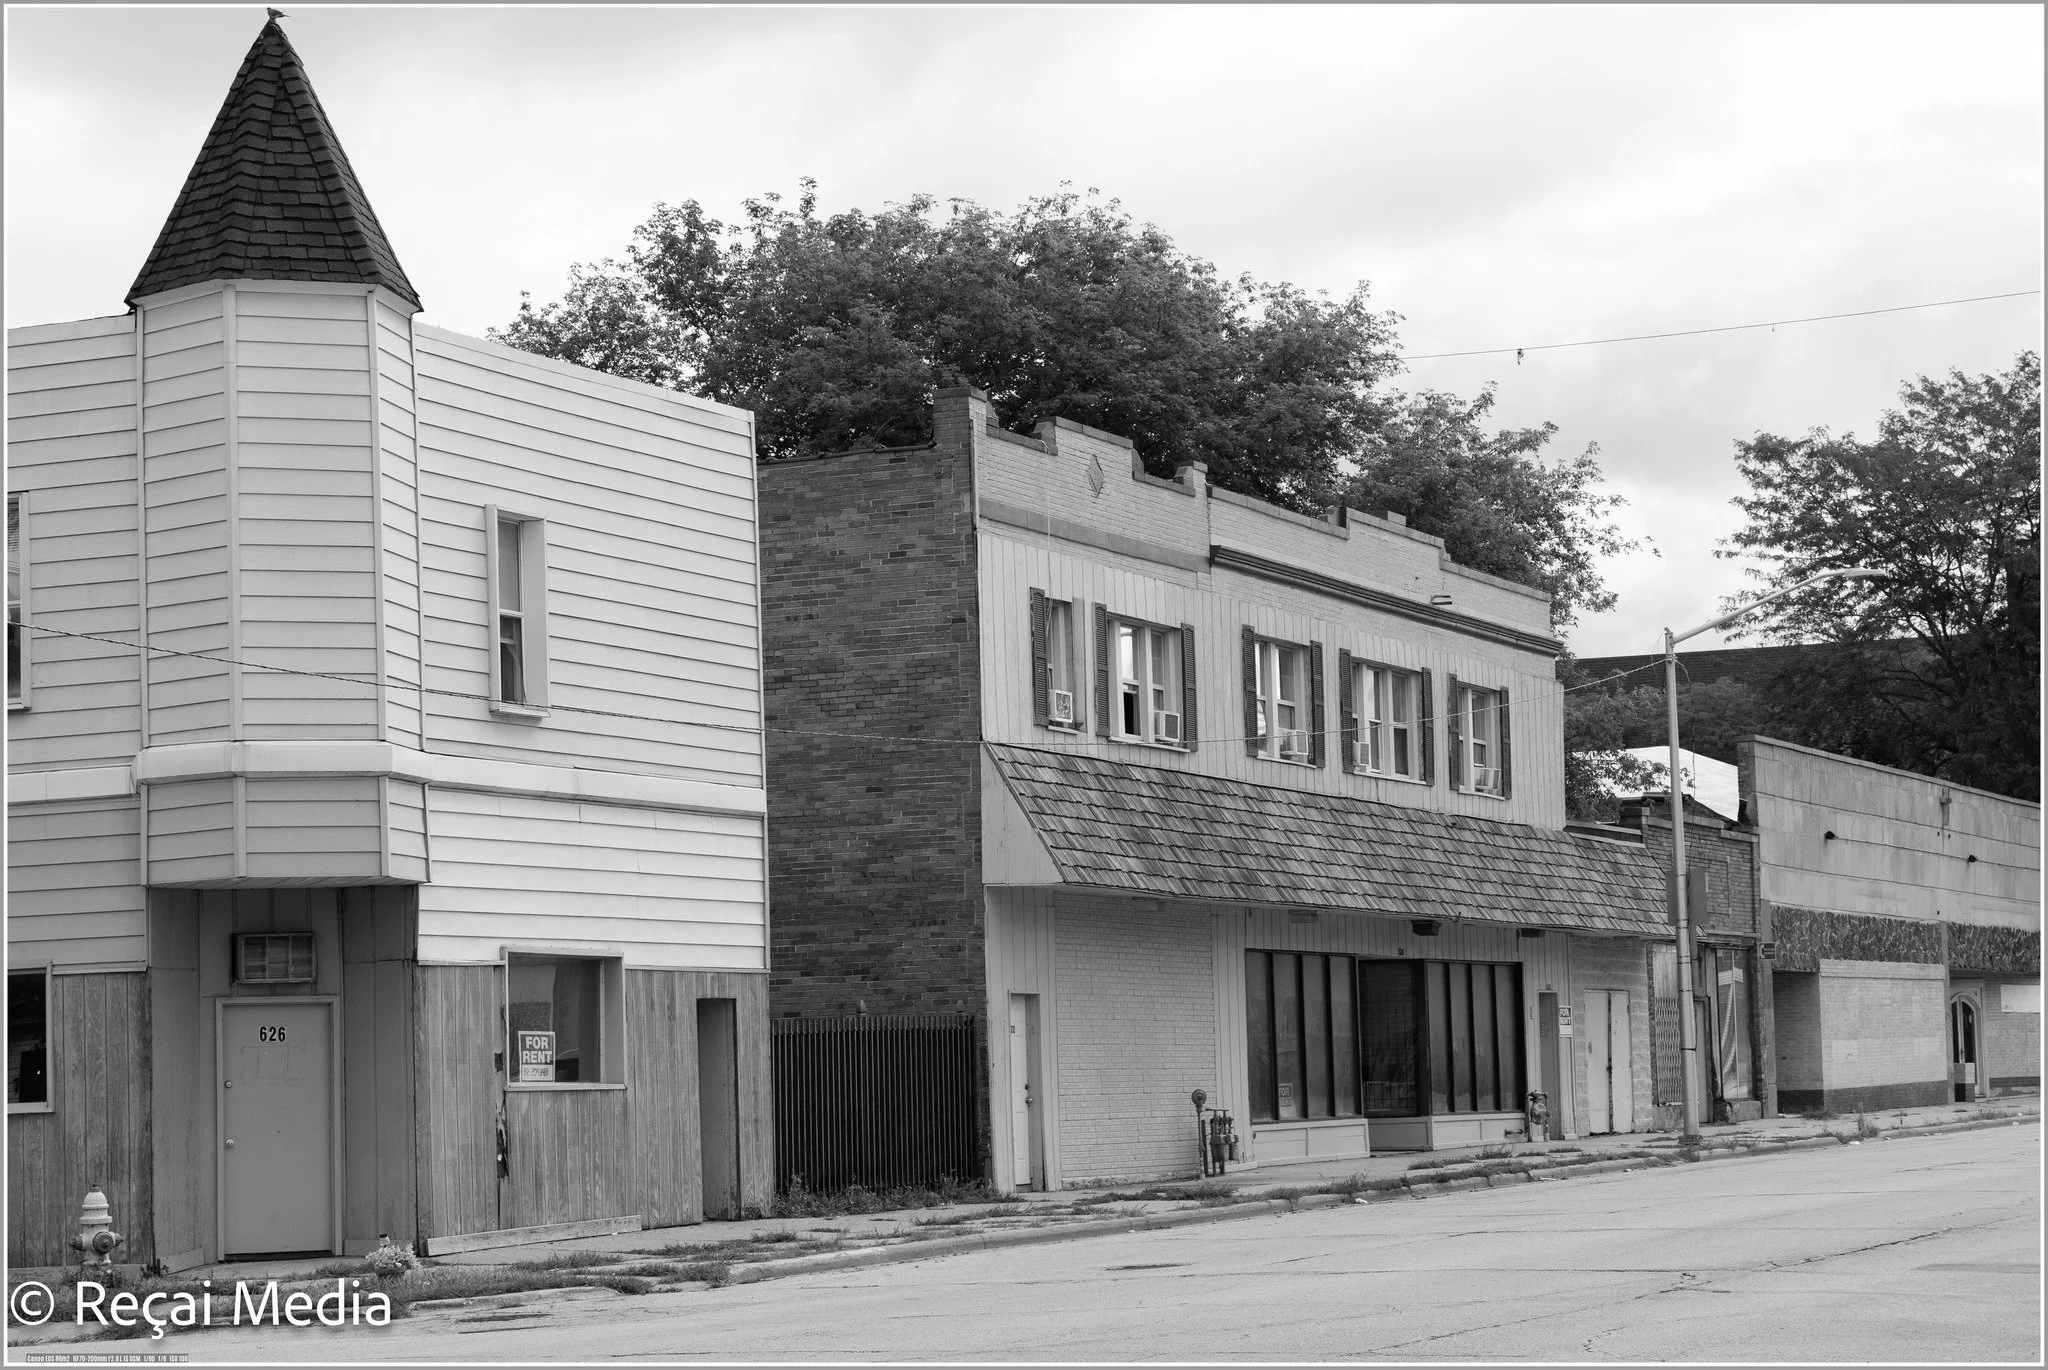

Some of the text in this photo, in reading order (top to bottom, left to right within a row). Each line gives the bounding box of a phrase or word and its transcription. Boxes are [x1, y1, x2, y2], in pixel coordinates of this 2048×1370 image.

[259, 1026, 286, 1042] 626
[525, 1036, 549, 1050] FOR
[522, 1050, 552, 1064] RENT
